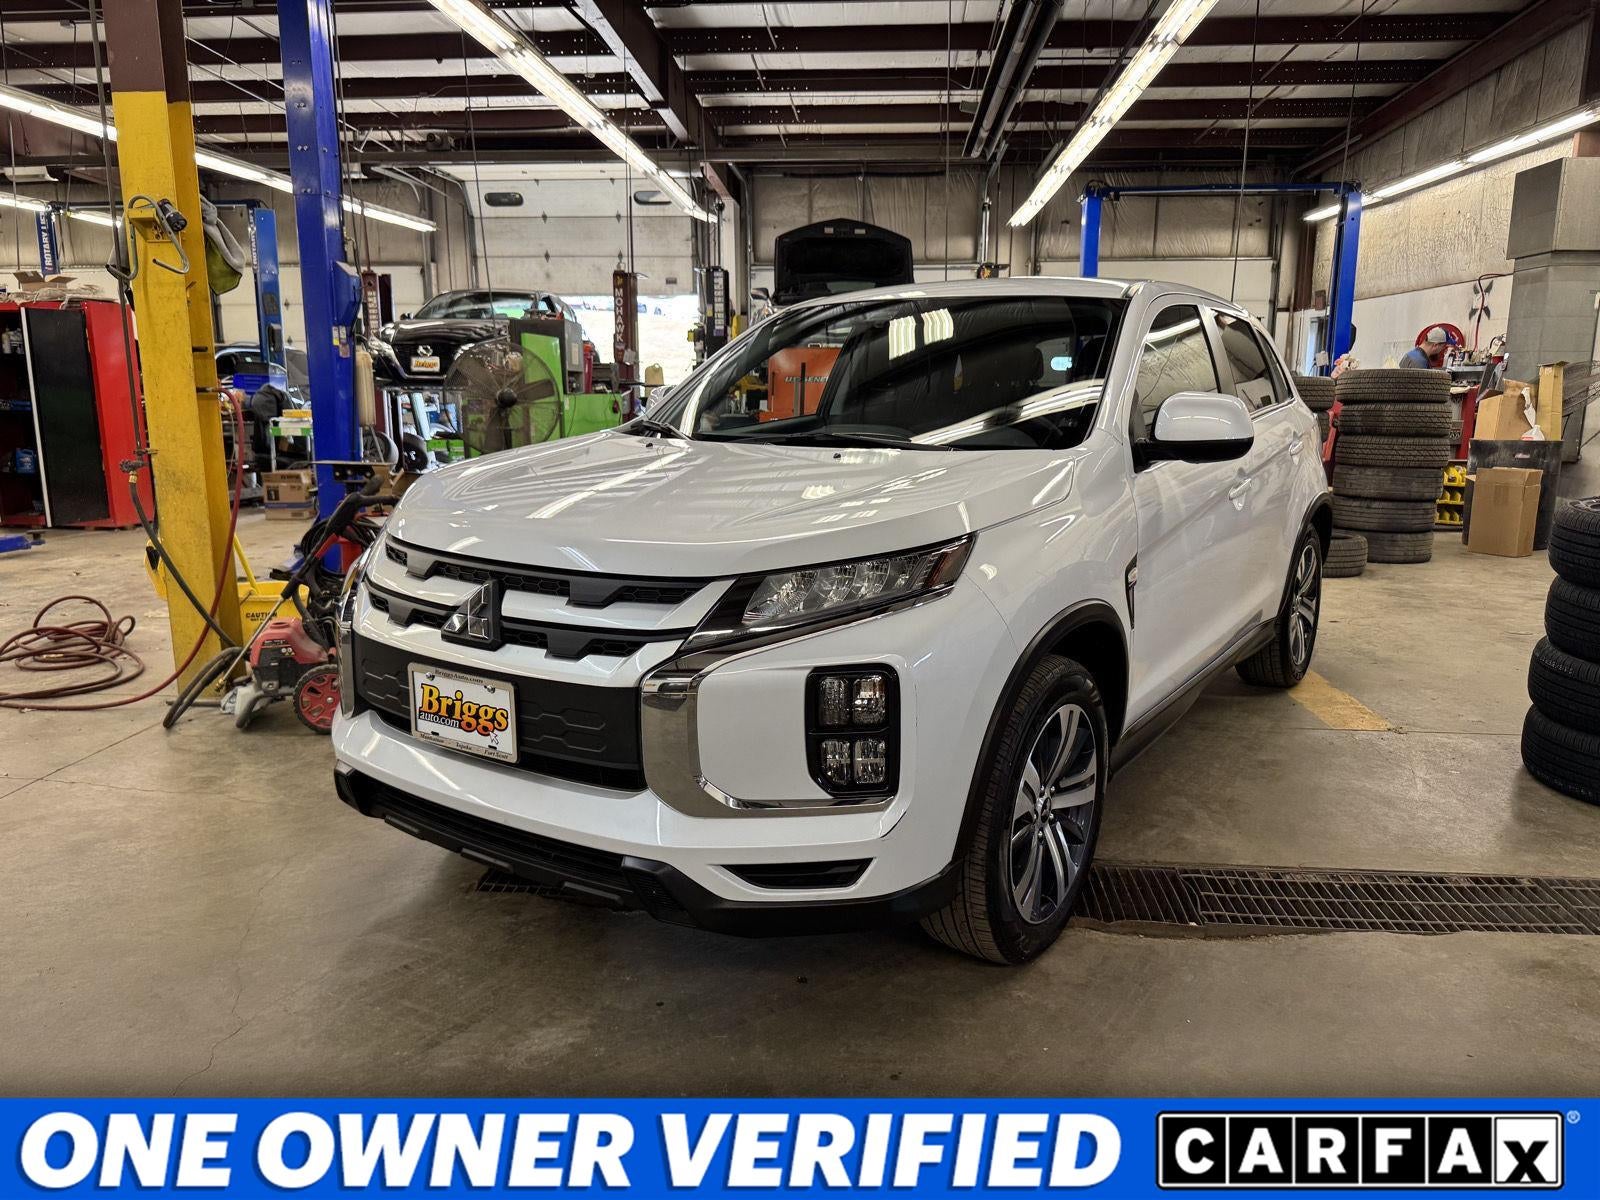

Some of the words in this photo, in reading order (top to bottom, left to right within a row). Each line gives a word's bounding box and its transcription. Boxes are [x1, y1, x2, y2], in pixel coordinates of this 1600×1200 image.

[615, 287, 624, 342] MOHAWK
[419, 711, 460, 729] auto.com
[420, 683, 509, 737] Briggs
